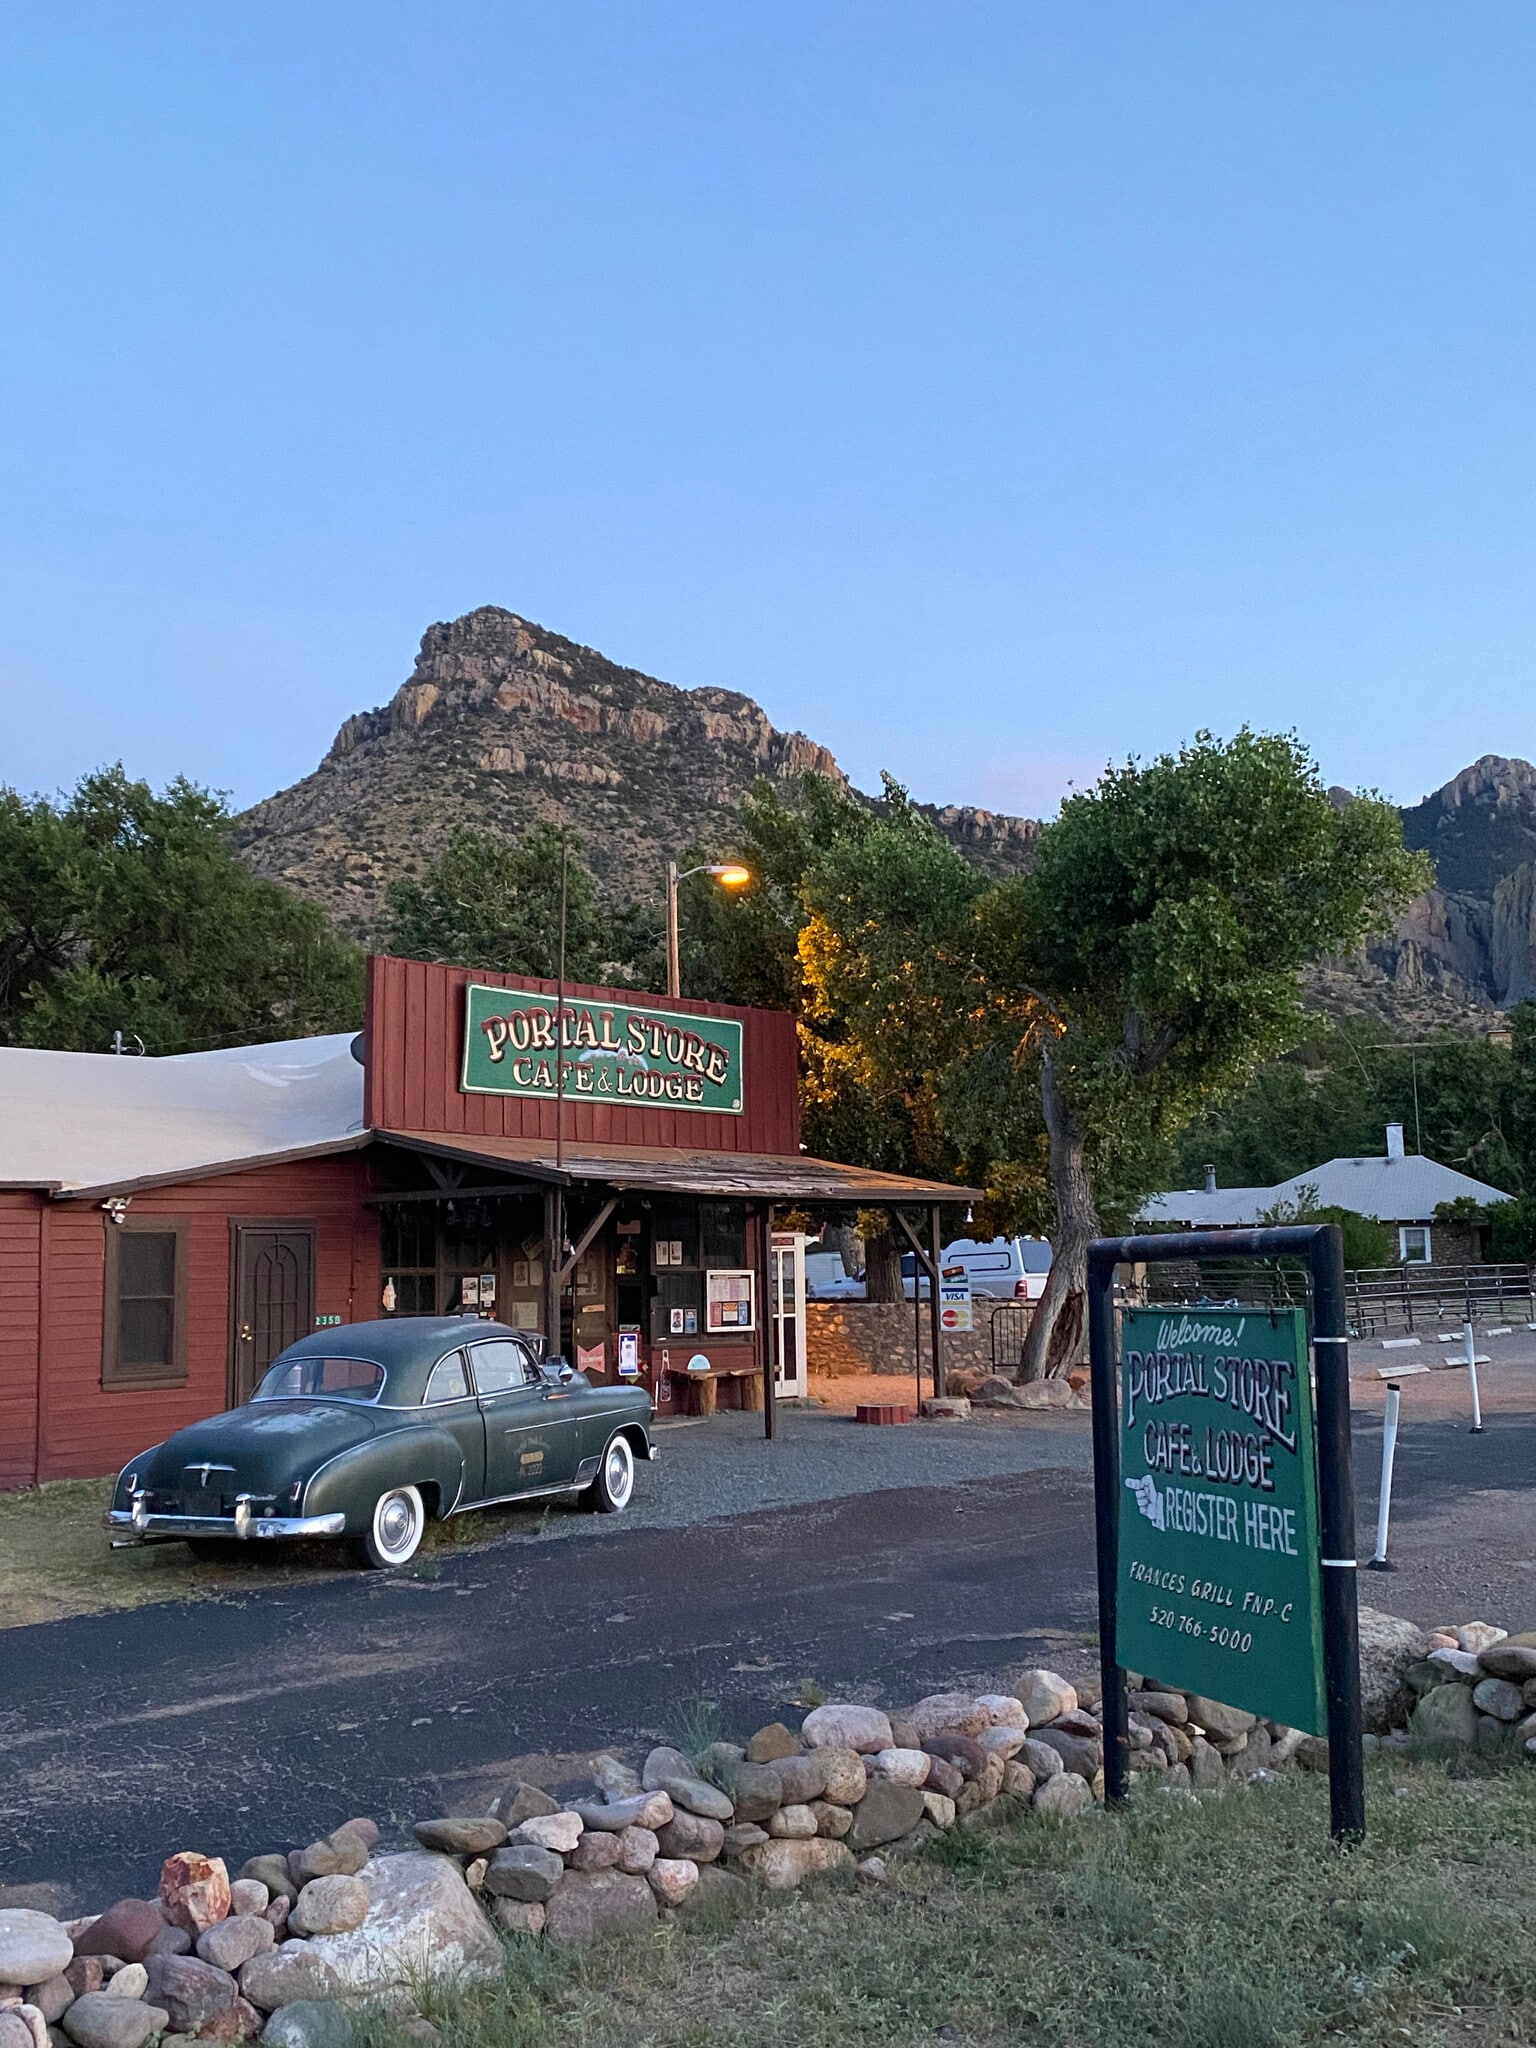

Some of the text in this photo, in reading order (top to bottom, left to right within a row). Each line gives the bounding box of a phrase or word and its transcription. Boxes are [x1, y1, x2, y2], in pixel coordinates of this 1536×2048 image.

[480, 1006, 730, 1086] PORTAL STORE
[512, 1057, 704, 1102] CAFE & LODGE
[946, 1292, 964, 1301] VISA
[1157, 1314, 1246, 1351] Welcome!
[1127, 1351, 1297, 1449] PORTAL STORE
[1143, 1419, 1275, 1490] CAFE & LODGE
[1165, 1486, 1298, 1556] REGISTER HERE
[1130, 1561, 1293, 1622] FRANCES GRILL FNP-C
[1149, 1606, 1252, 1653] 520 766-5000
